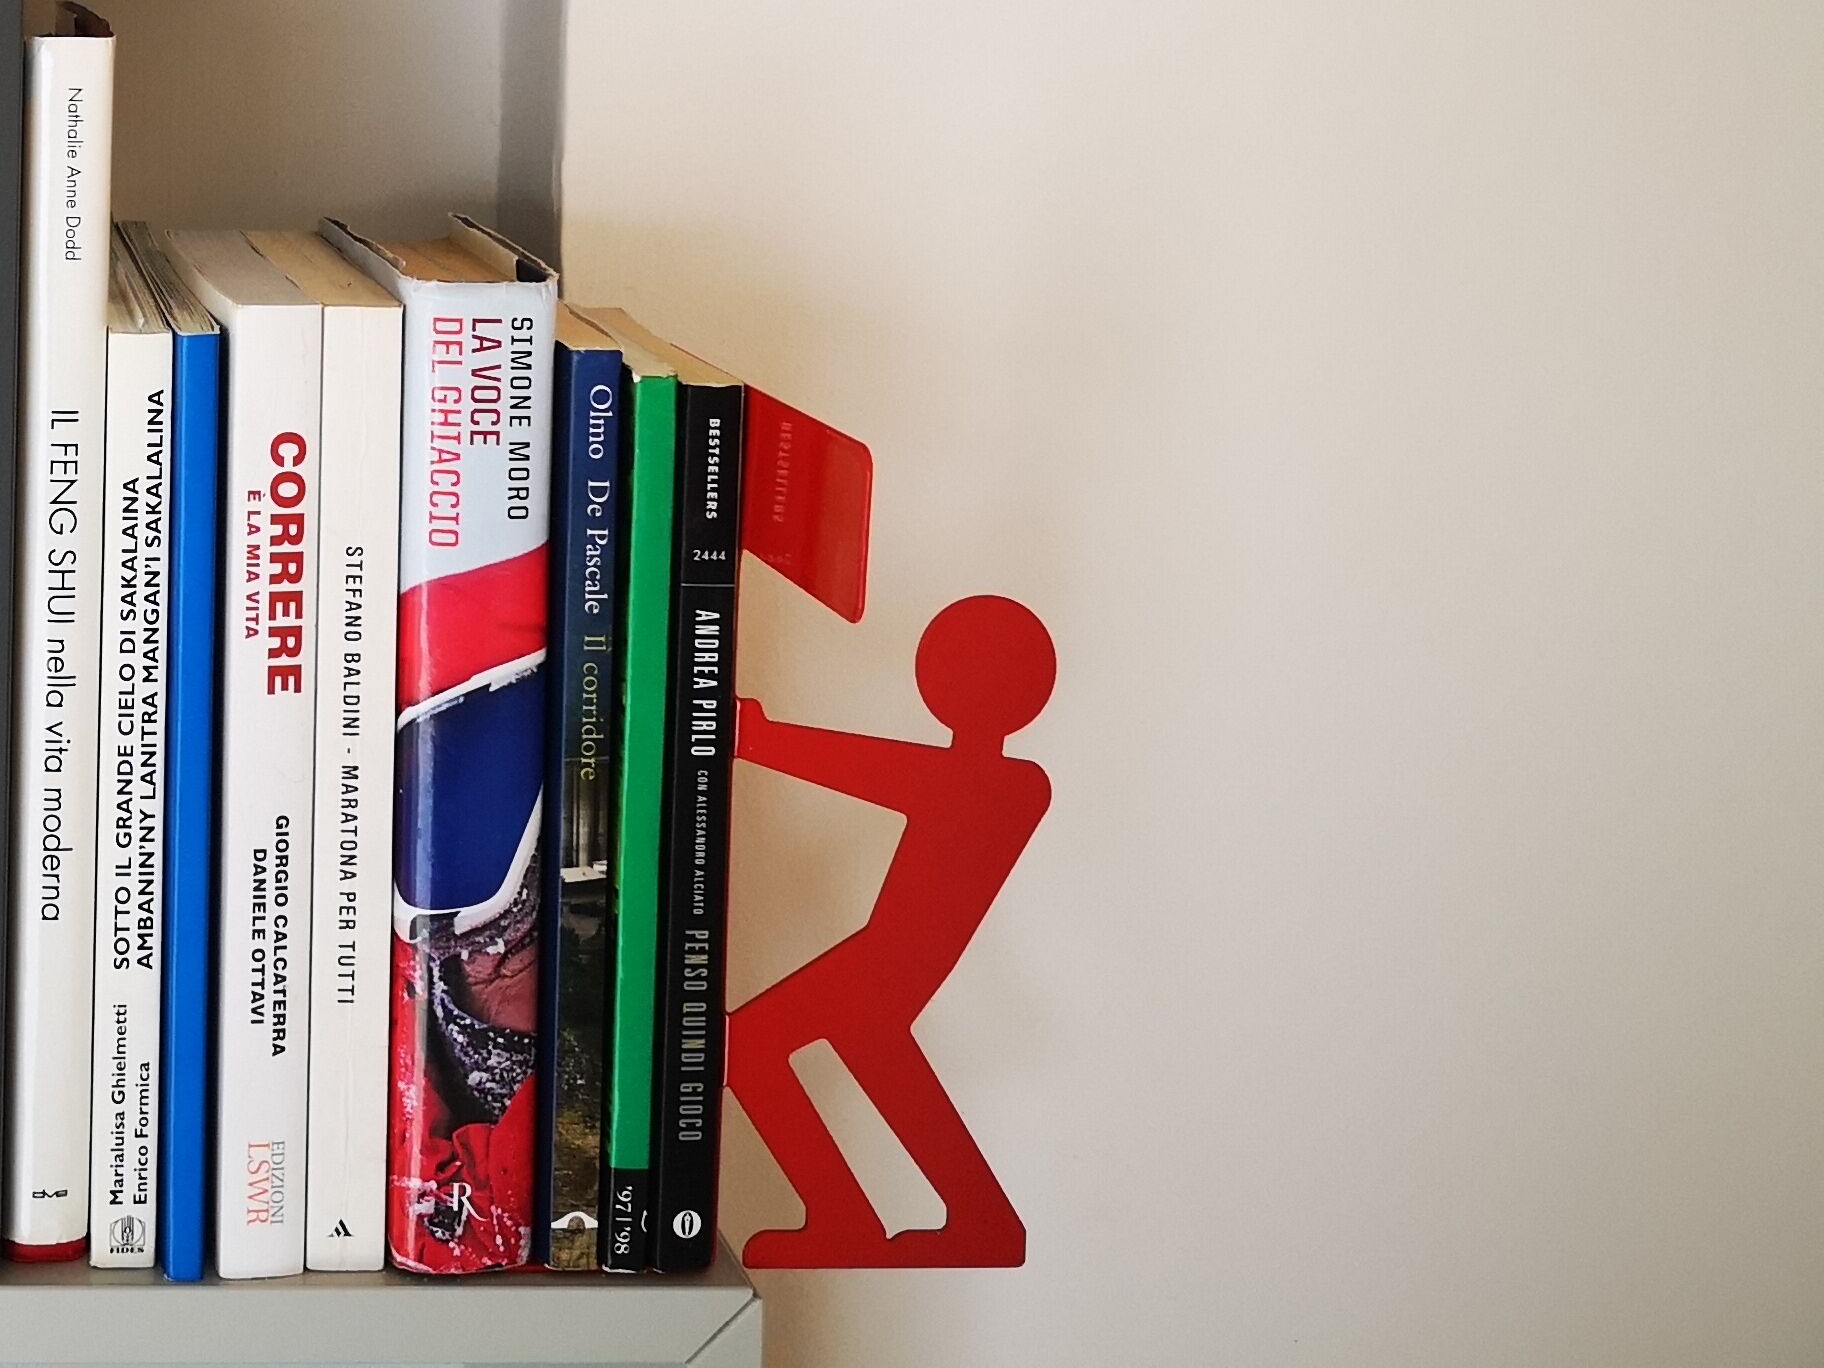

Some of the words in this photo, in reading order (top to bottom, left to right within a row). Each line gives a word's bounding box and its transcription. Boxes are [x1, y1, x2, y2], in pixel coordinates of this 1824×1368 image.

[66, 87, 84, 159] Nathalie
[66, 165, 82, 209] Anne
[65, 216, 82, 261] Dodd
[431, 317, 464, 374] DEL
[471, 317, 503, 354] LA
[509, 317, 534, 428] SIMONE
[50, 410, 79, 430] IL
[469, 364, 502, 446] VOCE
[588, 384, 613, 460] Olmo
[48, 443, 79, 535] FENG
[144, 389, 165, 548] SAKALALINA
[428, 386, 463, 547] GHIACCIO
[507, 441, 531, 520] MORO
[586, 480, 610, 517] De
[705, 418, 721, 520] BESTSELLERS
[119, 477, 140, 621] SAKALAINA
[246, 510, 261, 536] LA
[692, 549, 726, 561] 2444
[47, 548, 77, 623] SHUI
[245, 544, 261, 583] MIA
[267, 431, 307, 695] CORRERE
[344, 546, 364, 642] STEFANO
[584, 528, 609, 615] Pascale
[119, 630, 136, 654] DI
[142, 556, 162, 683] MANGAN'I
[244, 590, 261, 640] VITA
[693, 609, 721, 689] ANDREA
[45, 638, 76, 708] nella
[117, 663, 136, 736] CIELO
[342, 653, 362, 737] BALDINI
[43, 721, 71, 773] vita
[139, 691, 159, 800] LANITRA
[580, 662, 604, 781] corridore
[690, 699, 718, 756] PIRLO
[115, 744, 134, 849] GRANDE
[696, 769, 709, 791] CON
[41, 788, 74, 921] moderna
[274, 815, 290, 908] GIORGIO
[339, 764, 360, 881] MARATONA
[694, 795, 708, 865] ALESSANDRO
[115, 857, 132, 877] IL
[136, 808, 156, 970] AMBANIN'NY
[251, 848, 268, 941] DANIELE
[692, 869, 705, 915] ALCIATO
[114, 886, 131, 970] SOTTO
[338, 891, 357, 931] PER
[250, 947, 266, 1025] OTTAVI
[271, 914, 289, 1057] CALCATERRA
[337, 940, 356, 1004] TUTTI
[683, 930, 710, 991] PENSO
[110, 1003, 128, 1105] Ghielmetti
[680, 1002, 707, 1071] QUINDI
[134, 1061, 150, 1139] Formica
[678, 1082, 705, 1141] GIOCO
[109, 1111, 126, 1206] Marialuisa
[133, 1145, 149, 1205] Enrico
[246, 1142, 271, 1225] LSWR
[270, 1140, 286, 1225] EDIZIONI
